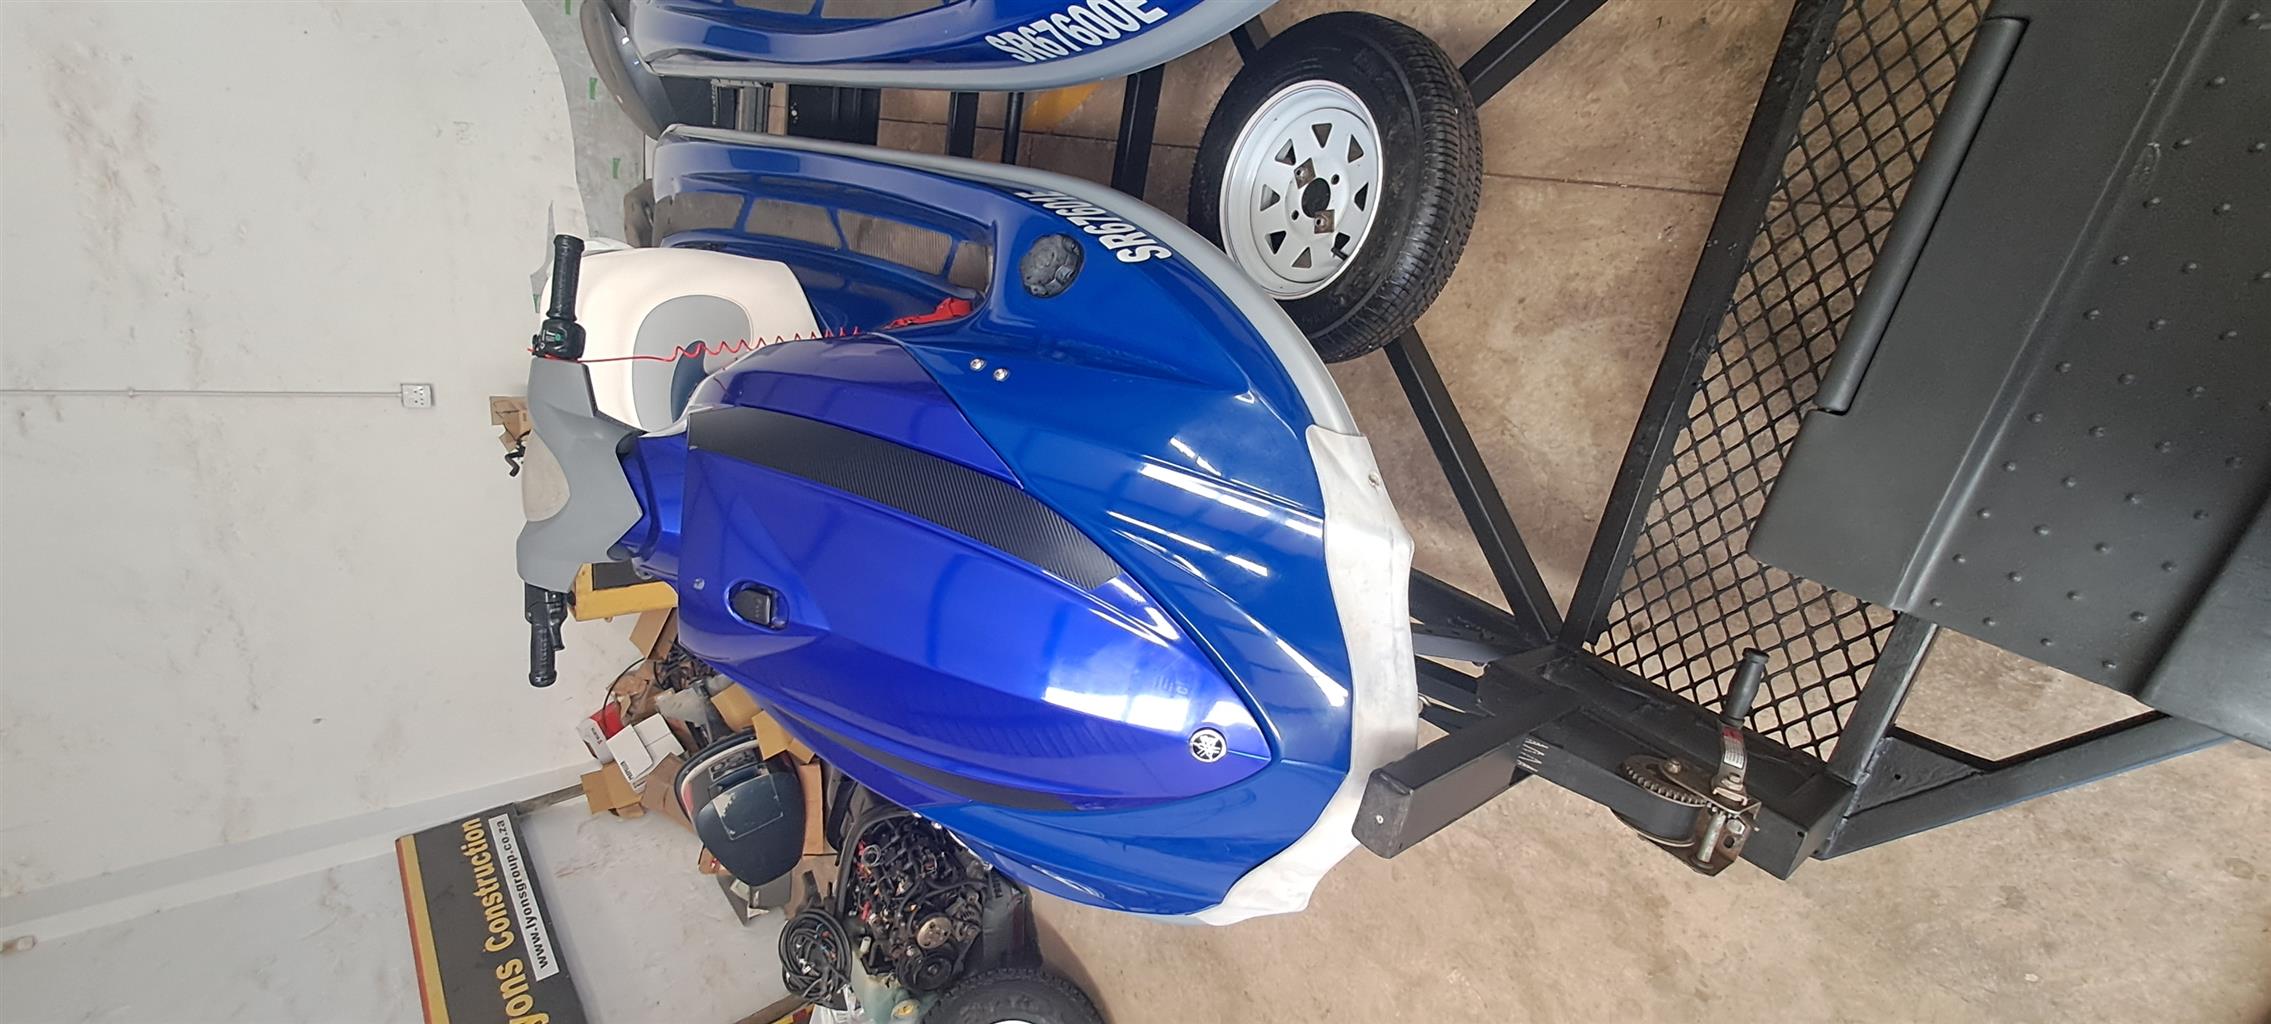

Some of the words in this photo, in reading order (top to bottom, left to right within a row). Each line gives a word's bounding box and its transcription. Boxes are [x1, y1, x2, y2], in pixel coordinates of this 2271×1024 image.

[985, 0, 1168, 63] SR67600E
[461, 817, 515, 952] Construction
[496, 820, 548, 969] www.lyonsgroup.co.za
